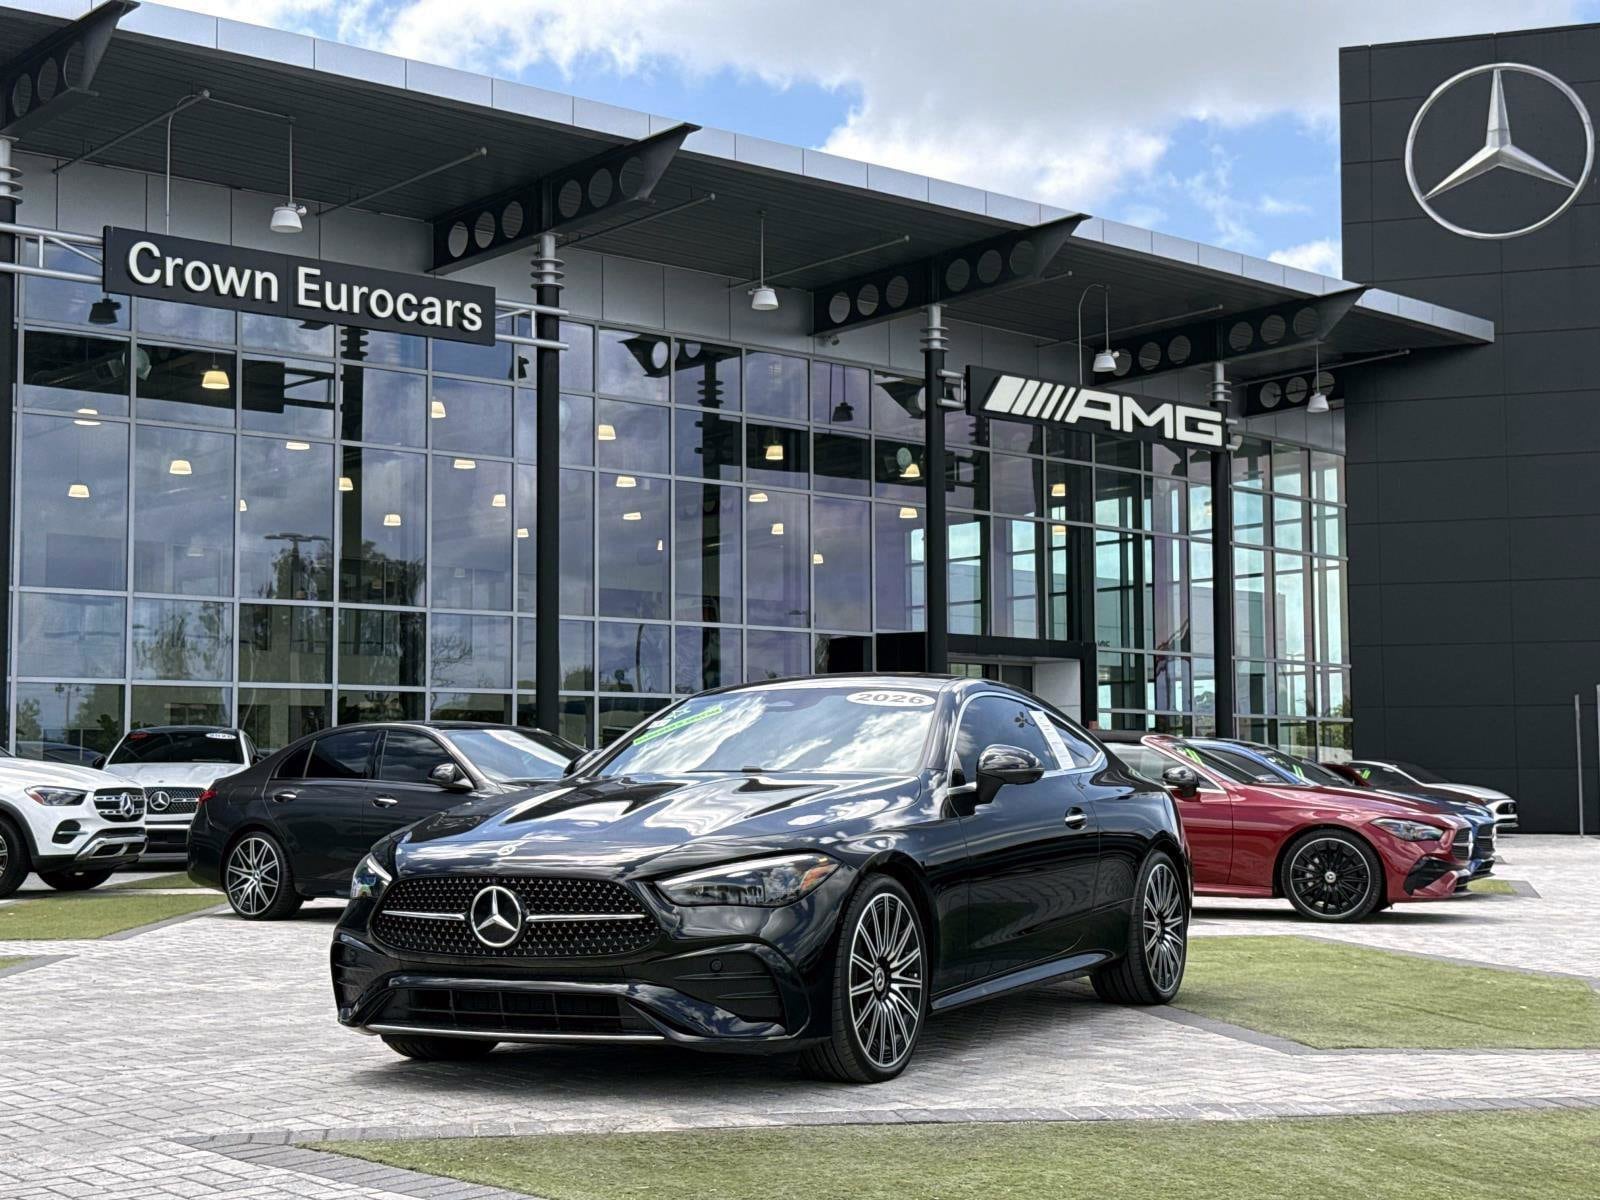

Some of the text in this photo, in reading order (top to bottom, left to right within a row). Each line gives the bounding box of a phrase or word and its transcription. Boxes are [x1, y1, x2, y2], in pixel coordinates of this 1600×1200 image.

[128, 241, 483, 331] Crown Eurocars
[1065, 388, 1222, 447] AMG
[855, 693, 925, 705] 2026
